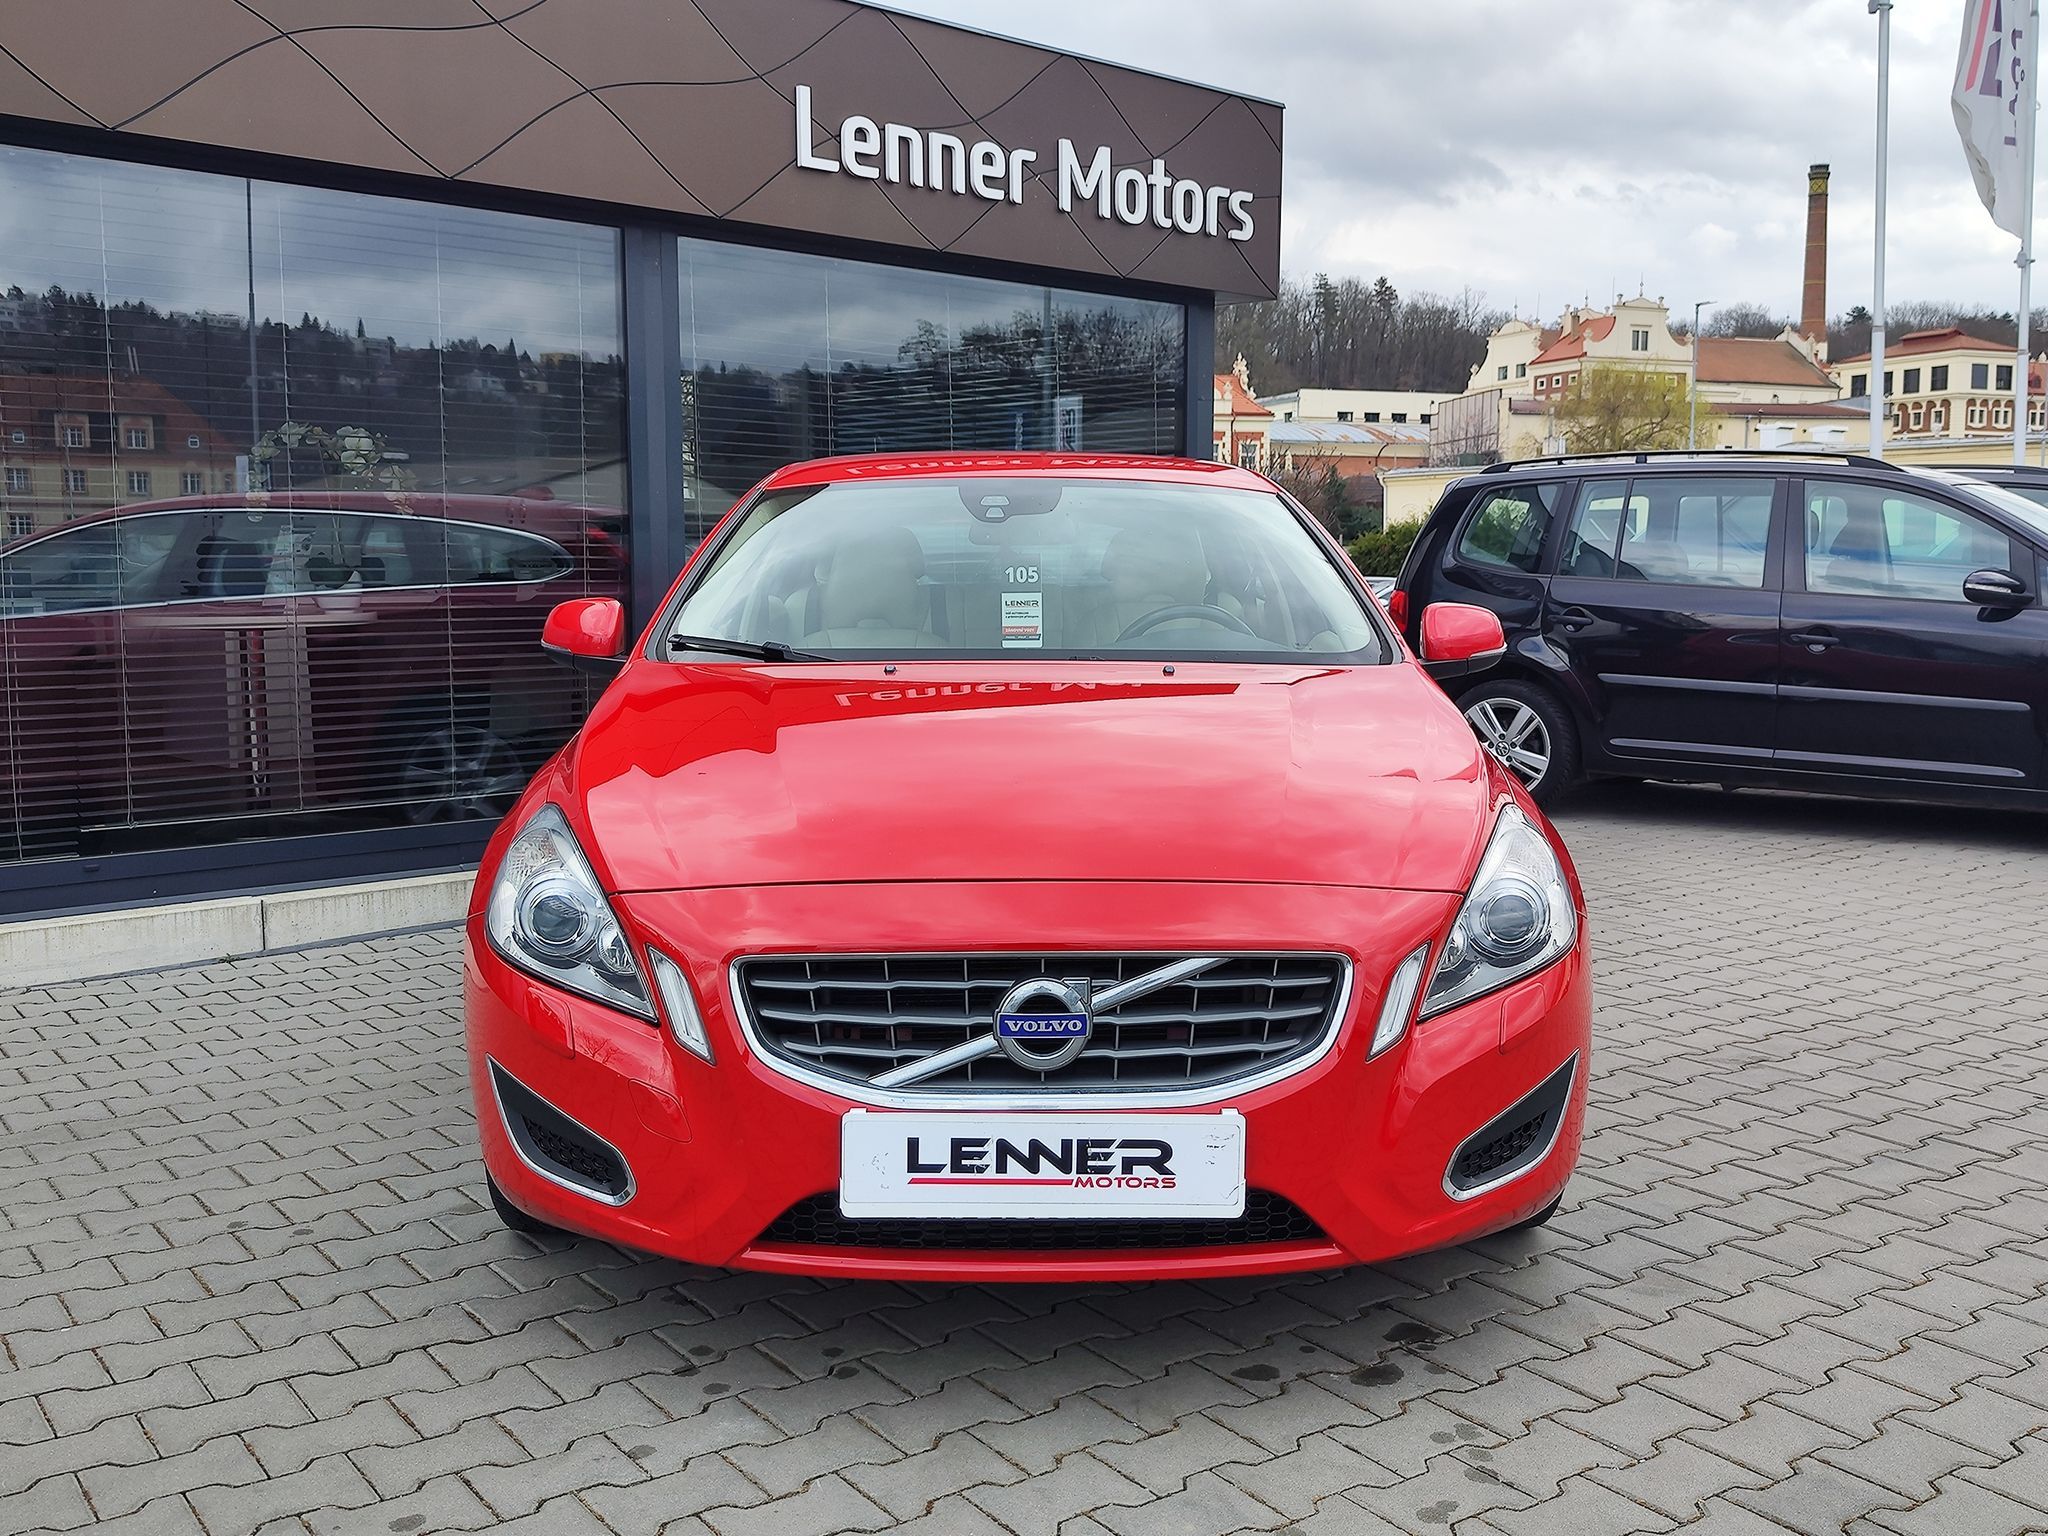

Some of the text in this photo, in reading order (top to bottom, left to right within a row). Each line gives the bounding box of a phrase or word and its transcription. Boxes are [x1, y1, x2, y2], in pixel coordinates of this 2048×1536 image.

[795, 85, 1255, 242] Lenner Motors
[1004, 566, 1039, 583] 105
[1004, 1020, 1082, 1031] VOLVO
[907, 1137, 1176, 1175] LENNER
[1074, 1176, 1177, 1188] MOTORS
